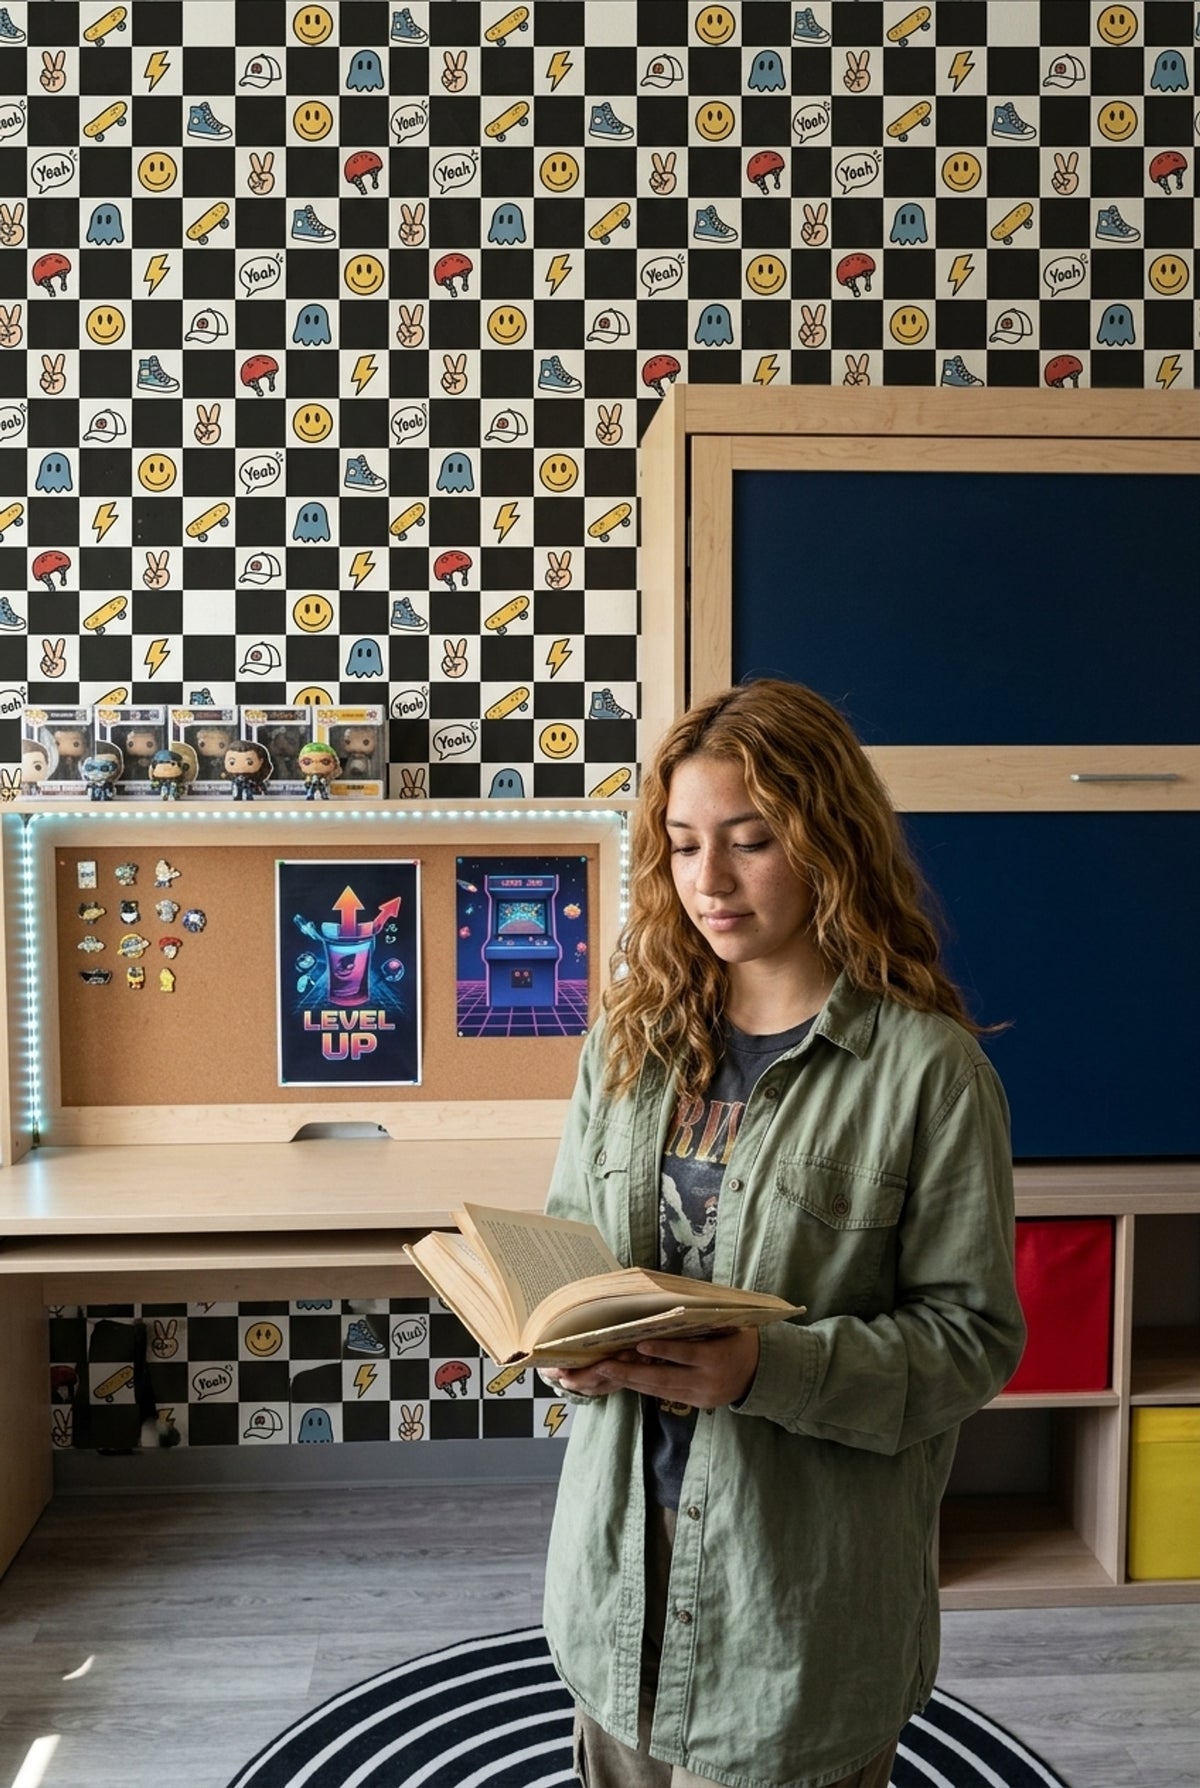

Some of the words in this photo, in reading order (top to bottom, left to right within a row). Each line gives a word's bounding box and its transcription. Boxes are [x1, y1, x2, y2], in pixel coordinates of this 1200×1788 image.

[37, 161, 70, 182] Yeah
[438, 161, 471, 182] Yeah
[646, 264, 678, 284] Yeah
[303, 1010, 396, 1031] LEVEL
[322, 1032, 377, 1060] UP
